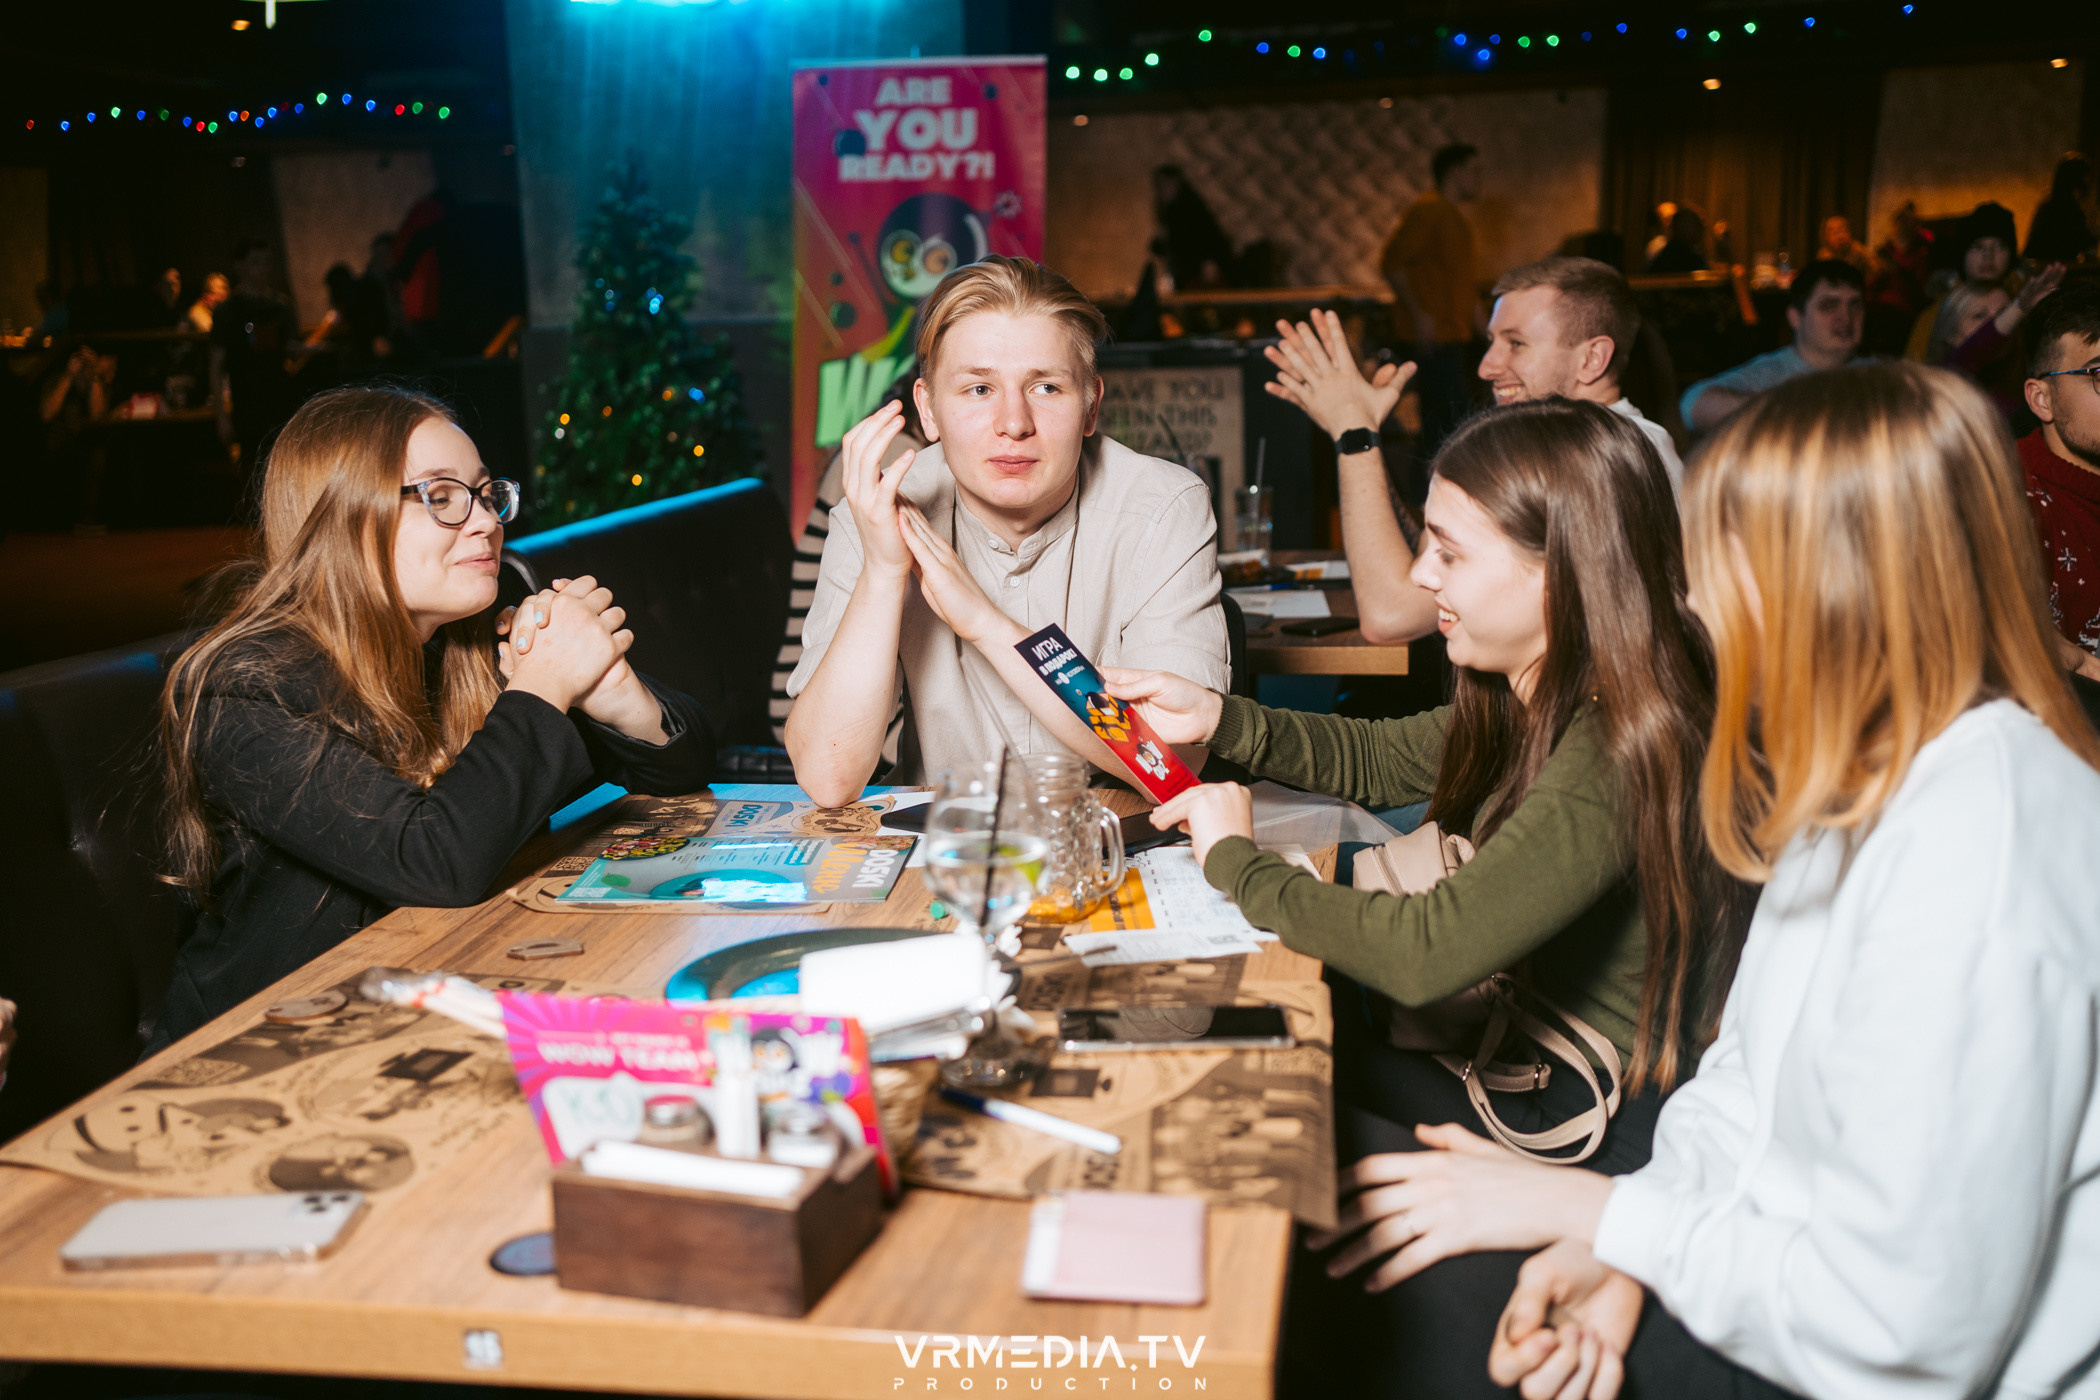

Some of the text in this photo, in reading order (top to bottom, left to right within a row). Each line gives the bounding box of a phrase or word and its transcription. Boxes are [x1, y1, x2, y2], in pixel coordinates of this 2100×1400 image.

[875, 77, 952, 105] ARE
[855, 108, 978, 151] YOU
[839, 152, 996, 182] READY?!
[1030, 636, 1064, 662] ИГРА
[724, 803, 763, 828] DOSKI
[851, 848, 899, 888] DOSKI
